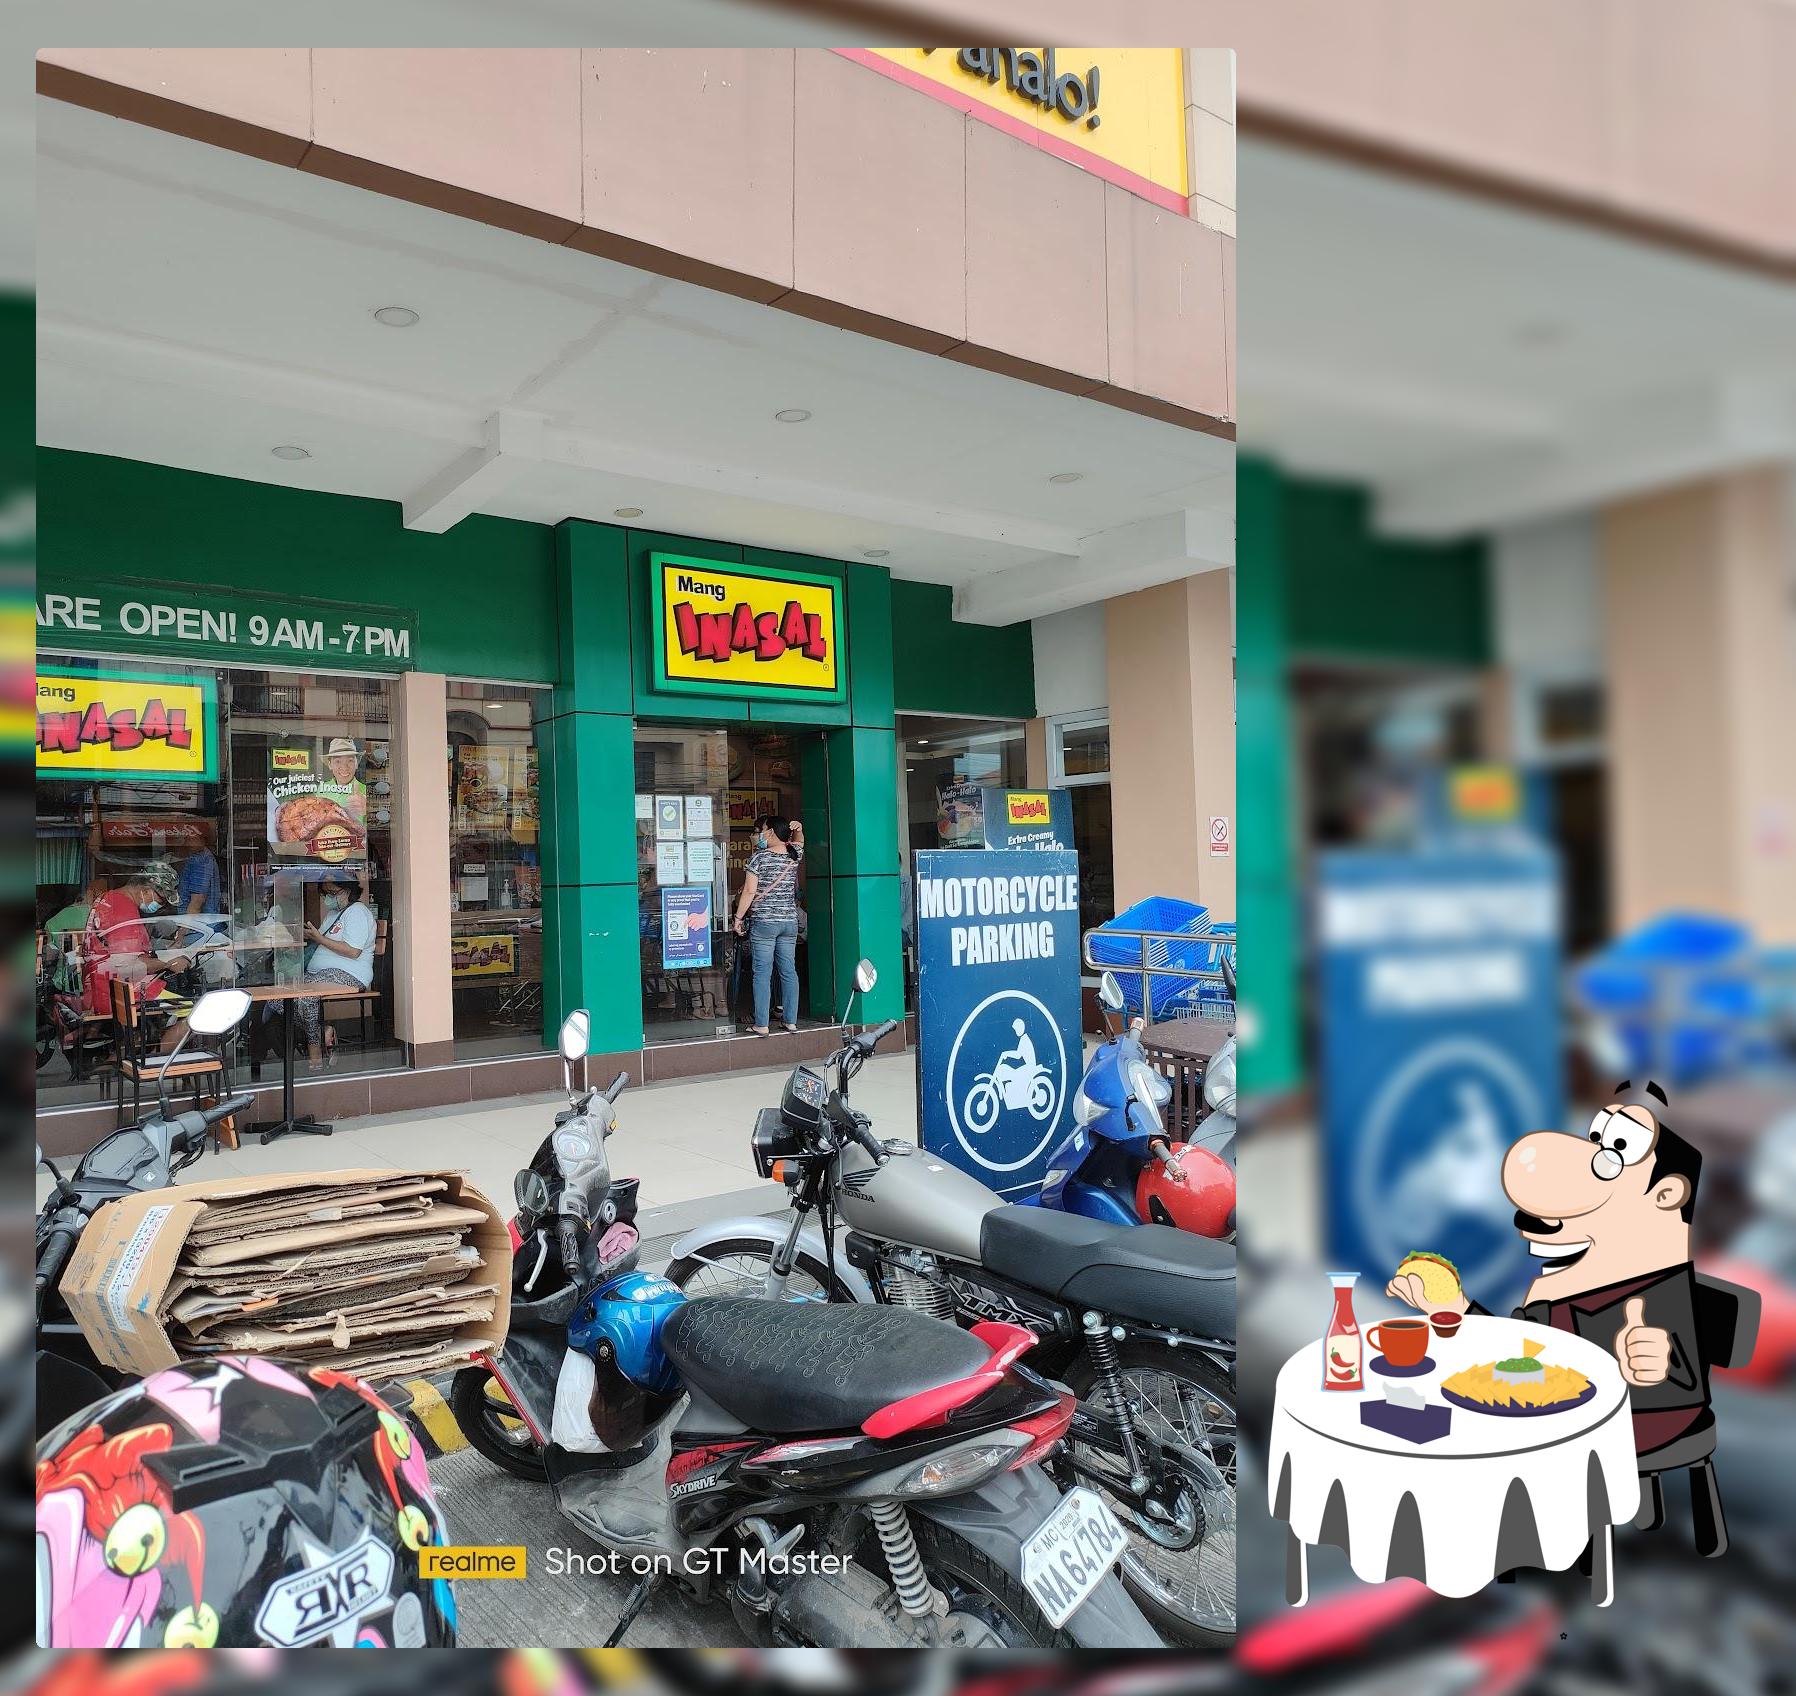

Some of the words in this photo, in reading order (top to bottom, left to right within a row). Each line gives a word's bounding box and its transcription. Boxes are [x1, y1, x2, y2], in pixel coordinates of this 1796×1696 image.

[922, 48, 1100, 131] analo!
[678, 575, 726, 601] Mang
[119, 602, 238, 643] OPEN!
[673, 601, 827, 663] INASAL
[36, 682, 77, 701] ang
[272, 776, 288, 785] Our
[287, 773, 315, 785] juiciest
[272, 782, 318, 799] Chicken
[1010, 799, 1047, 819] INASAL
[1007, 835, 1027, 846] Extra
[1027, 831, 1054, 842] Creamy
[920, 873, 1079, 920] MOTORCYCLE
[950, 921, 1055, 967] PARKING
[842, 1188, 876, 1203] HONDA
[960, 1293, 1042, 1331] TMX
[669, 1474, 716, 1499] SKYDRIVE
[1059, 1513, 1074, 1531] 2020
[1040, 1528, 1060, 1552] MC
